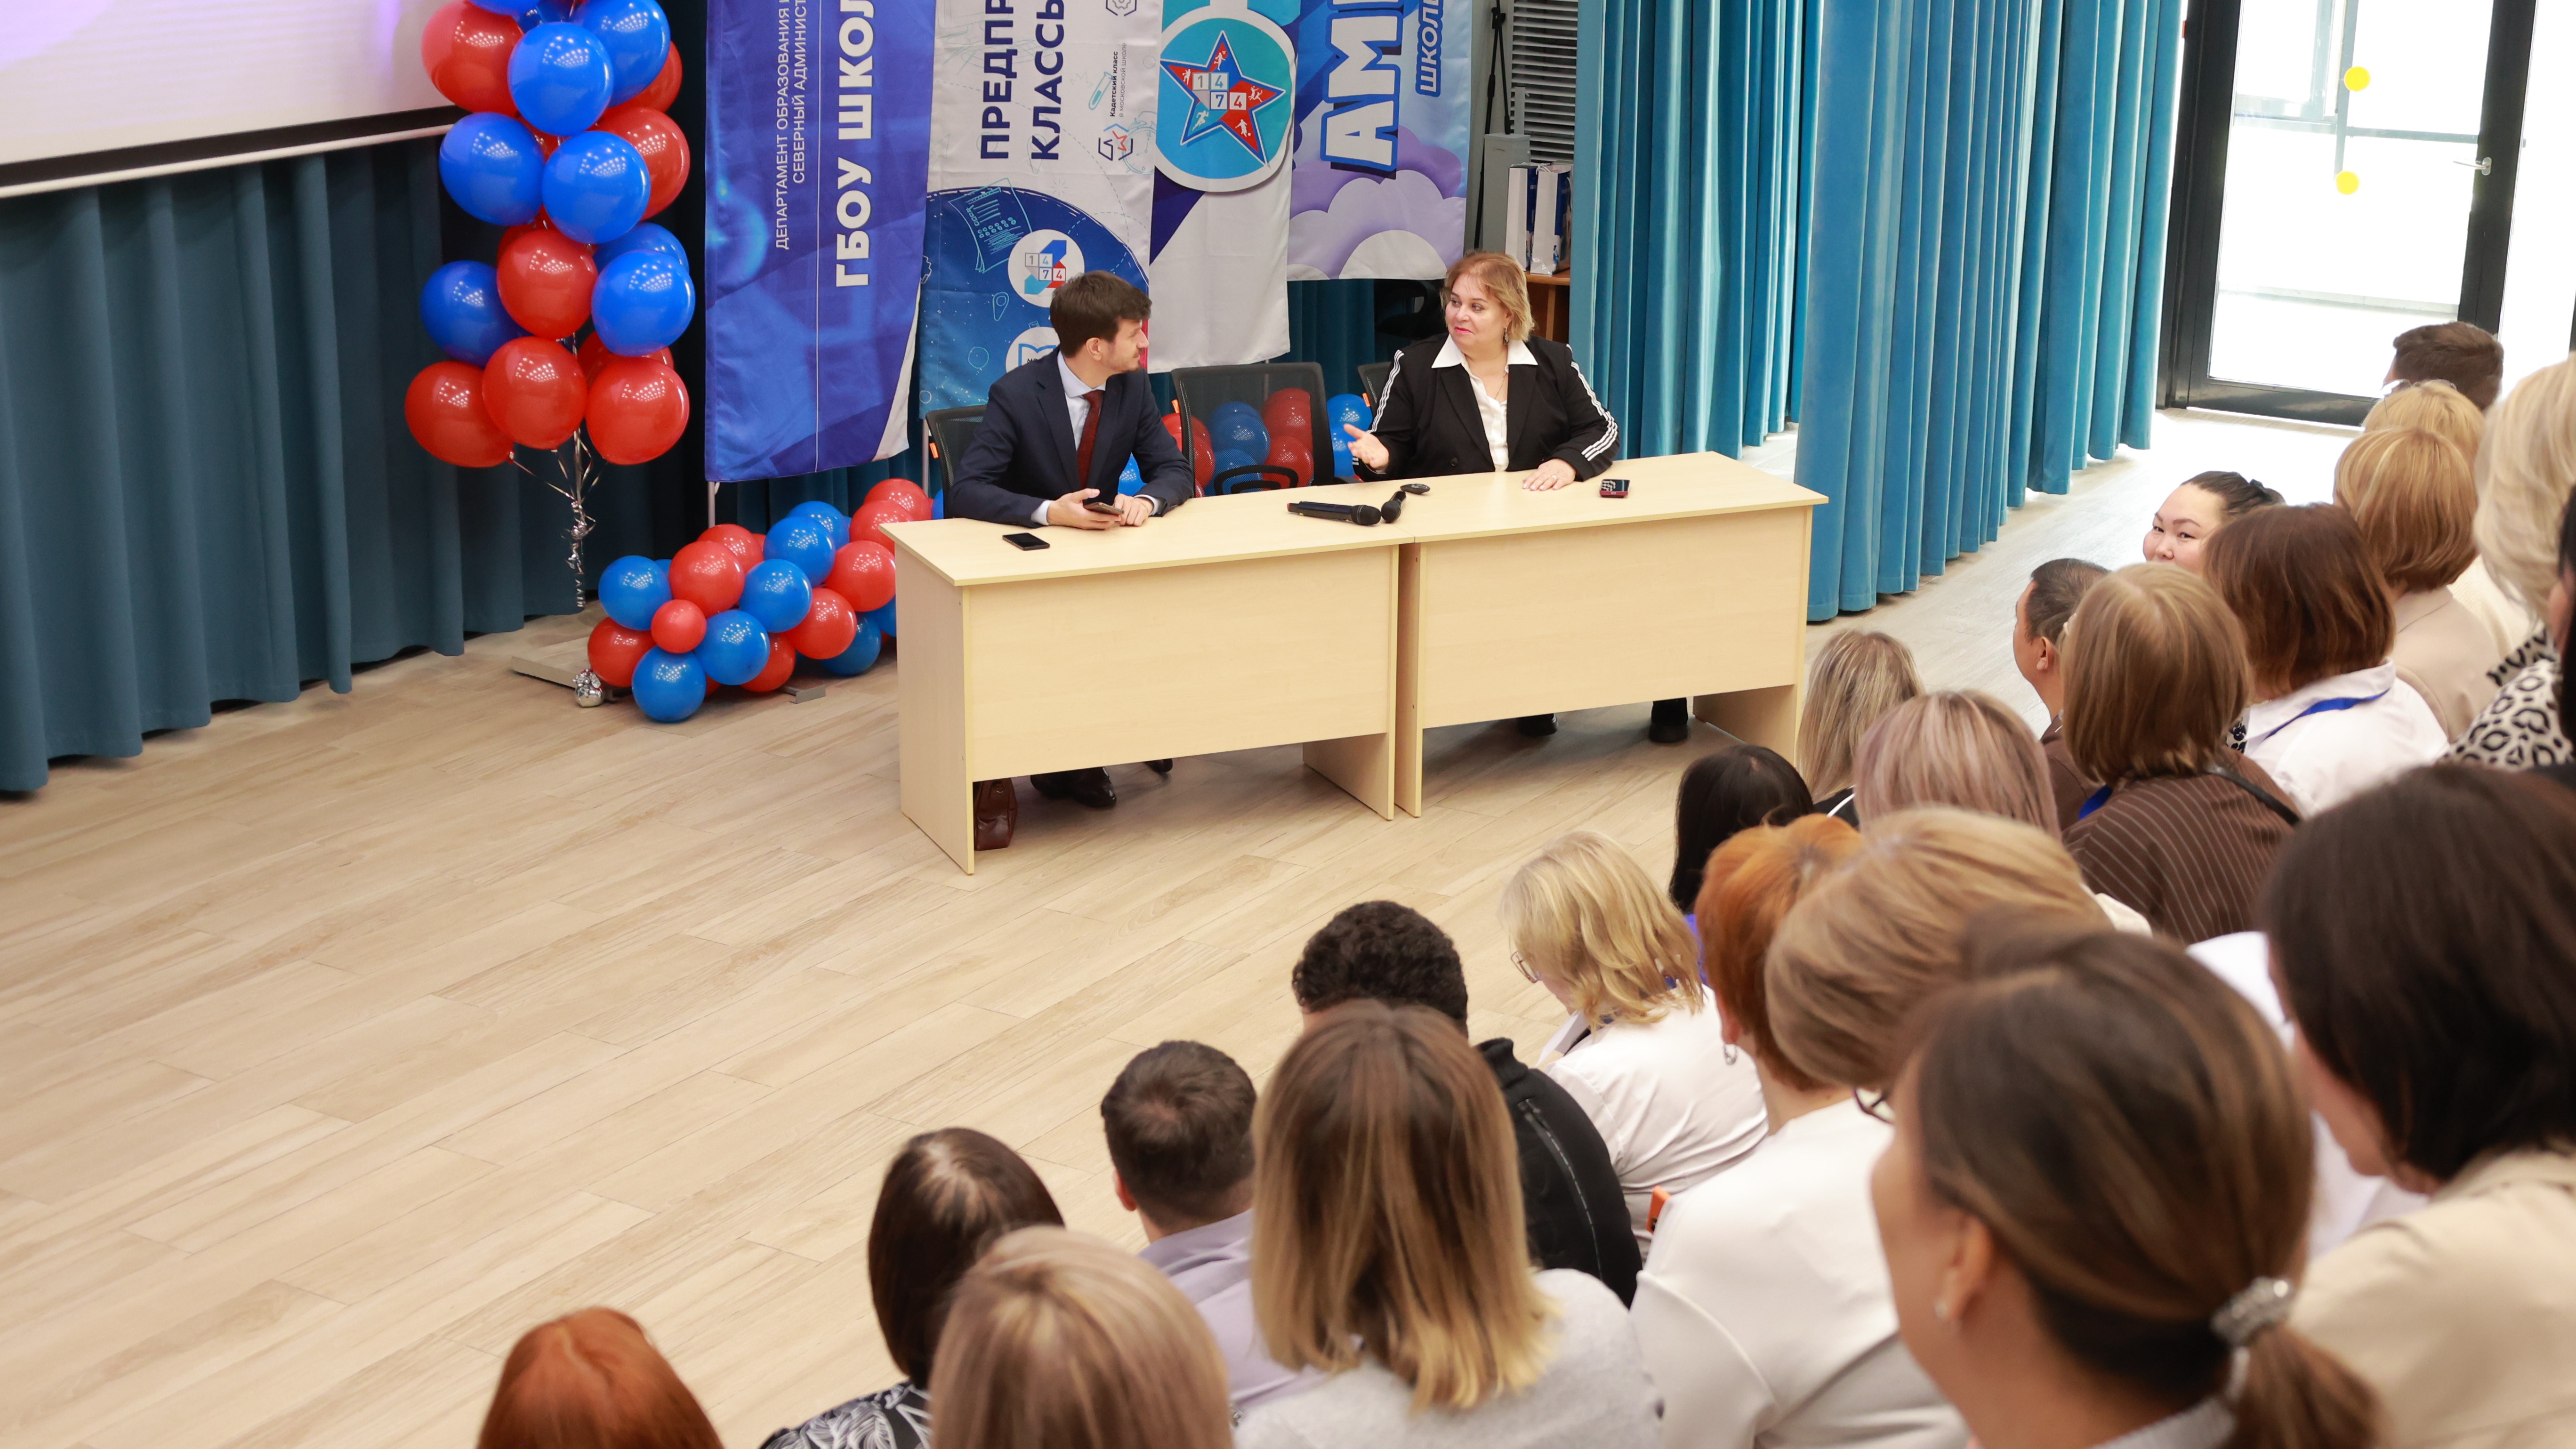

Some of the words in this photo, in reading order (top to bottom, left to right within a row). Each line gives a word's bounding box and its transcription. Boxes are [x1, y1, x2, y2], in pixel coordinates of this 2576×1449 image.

[776, 8, 790, 130] ОБРАЗОВАНИЯ
[794, 0, 808, 90] АДМИНИСТ
[981, 0, 1018, 159] ПРЕДПР
[1325, 0, 1399, 166] АМ
[776, 134, 789, 250] ДЕПАРТАМЕНТ
[791, 95, 805, 184] СЕВЕРНЫЙ
[836, 157, 872, 287] ГБОУ
